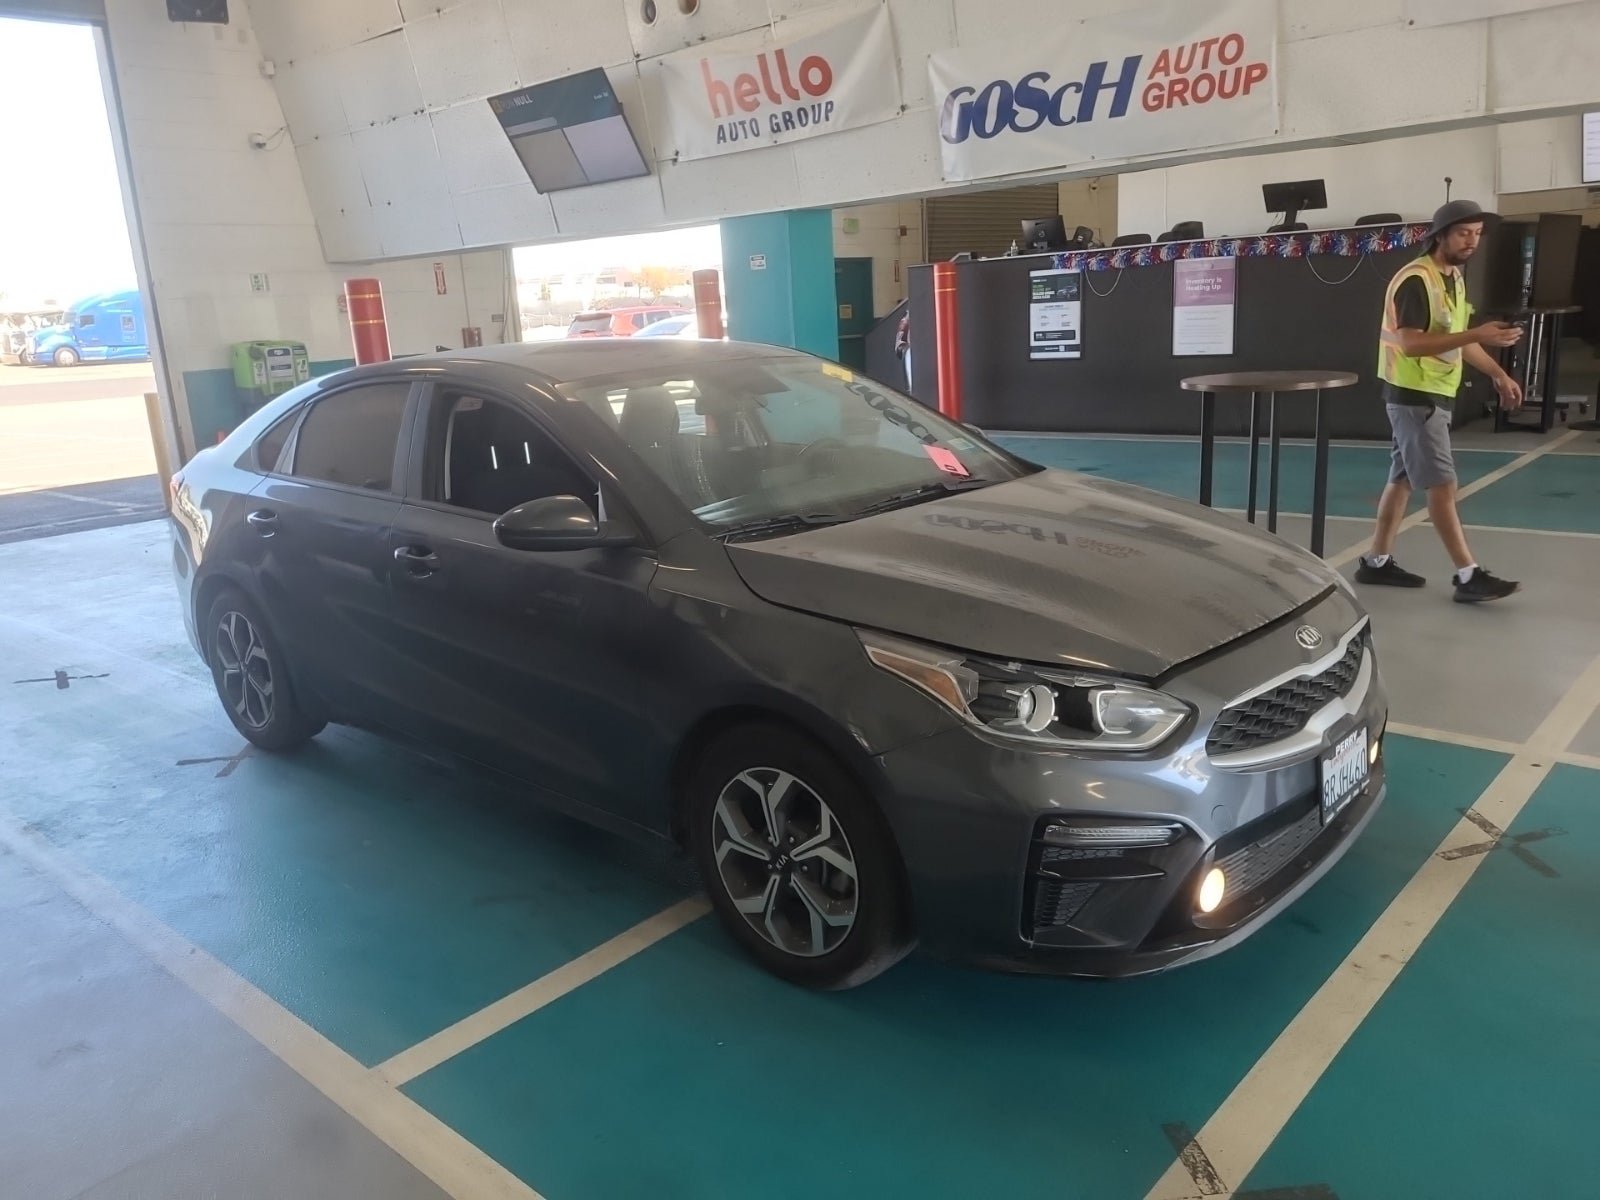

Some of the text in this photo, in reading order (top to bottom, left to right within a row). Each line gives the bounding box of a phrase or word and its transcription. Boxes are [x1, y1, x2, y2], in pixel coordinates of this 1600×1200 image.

[1147, 33, 1245, 80] AUTO
[700, 48, 833, 119] hello
[1141, 62, 1268, 112] GROUP
[716, 100, 835, 145] AUTO GROUP
[1335, 729, 1359, 756] PERRY
